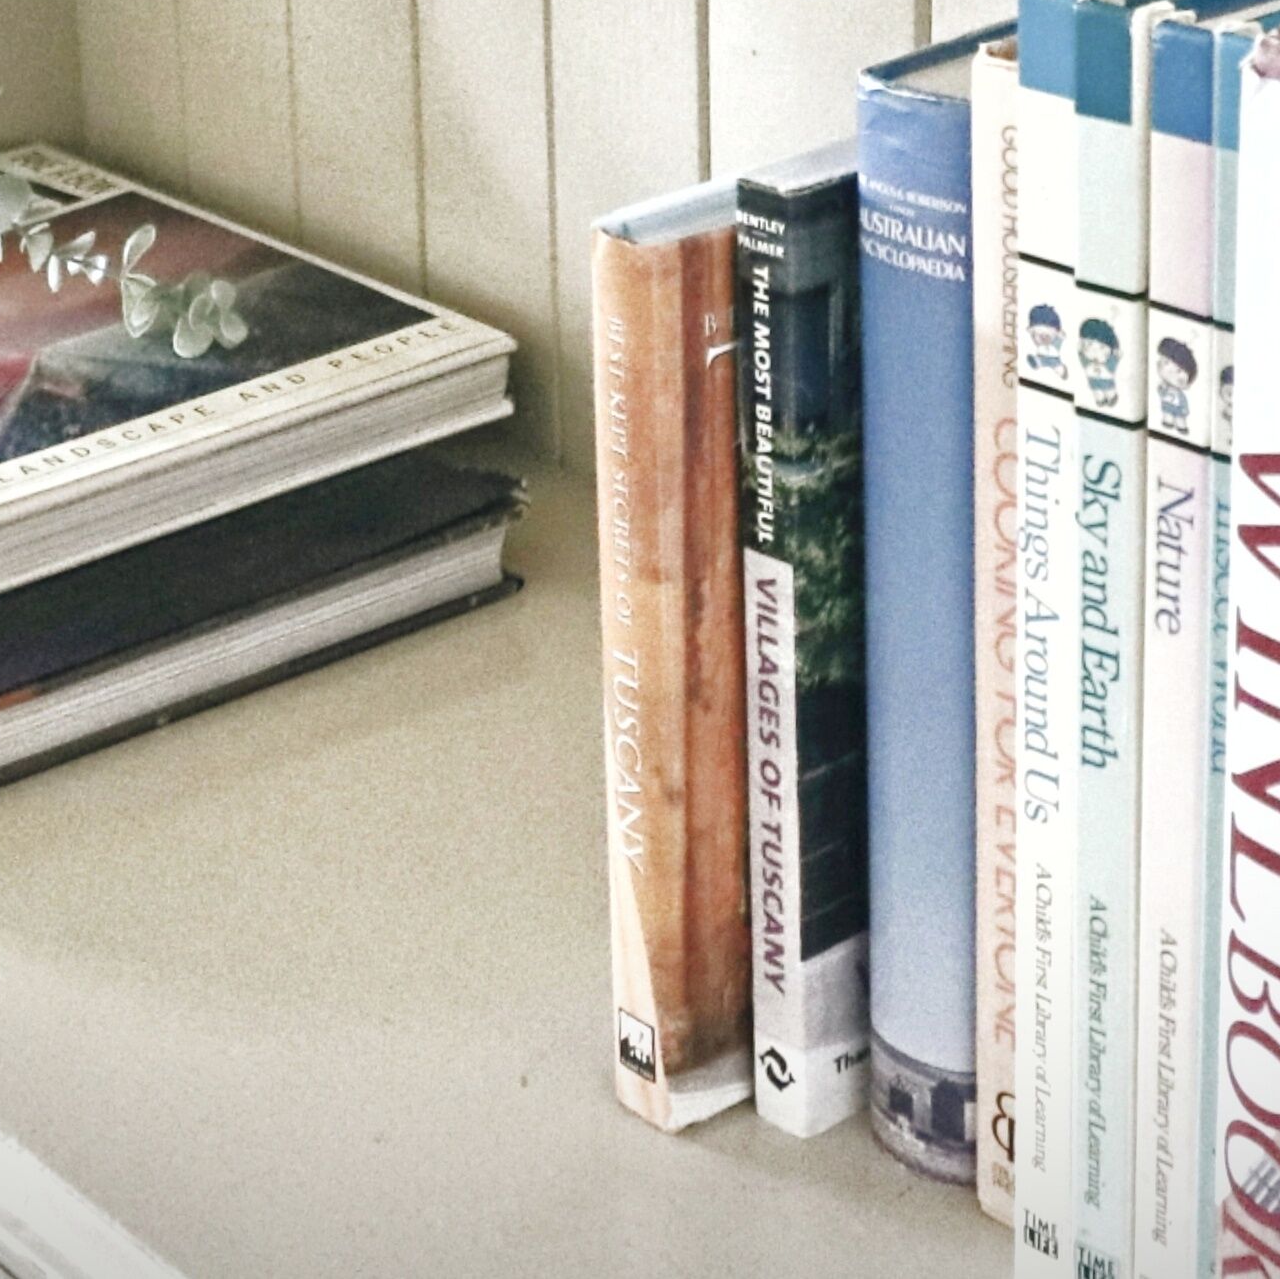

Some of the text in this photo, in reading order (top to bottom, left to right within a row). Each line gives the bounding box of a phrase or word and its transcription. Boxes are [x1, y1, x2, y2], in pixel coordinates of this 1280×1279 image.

[736, 209, 785, 235] BENTLEY
[737, 233, 784, 259] PALMER
[237, 371, 308, 404] AND
[326, 320, 460, 371] PEOPLE
[613, 473, 631, 583] SECRETS
[1155, 475, 1195, 636] Nature
[752, 265, 786, 994] THE MOST BEAUTIFUL VILLAGES OF TUSCANY
[1018, 425, 1061, 825] Things Around Us
[1075, 453, 1121, 771] Sky and Earth
[612, 649, 644, 875] TUSCANY
[1036, 862, 1052, 879] A
[1090, 894, 1108, 912] A
[1160, 928, 1178, 946] A
[1035, 945, 1052, 990] First
[1032, 993, 1052, 1061] Library
[1089, 978, 1107, 1024] First
[1085, 1027, 1107, 1098] Library
[1158, 1012, 1176, 1059] First
[1035, 1065, 1051, 1088] of
[1153, 1059, 1175, 1133] Library
[1032, 1086, 1051, 1173] Learning
[1088, 1099, 1106, 1124] of
[1084, 1121, 1106, 1212] Learning
[1156, 1133, 1173, 1159] of
[1024, 1208, 1057, 1237] TIME
[1152, 1156, 1173, 1248] Learning
[1078, 1245, 1115, 1276] TIME
